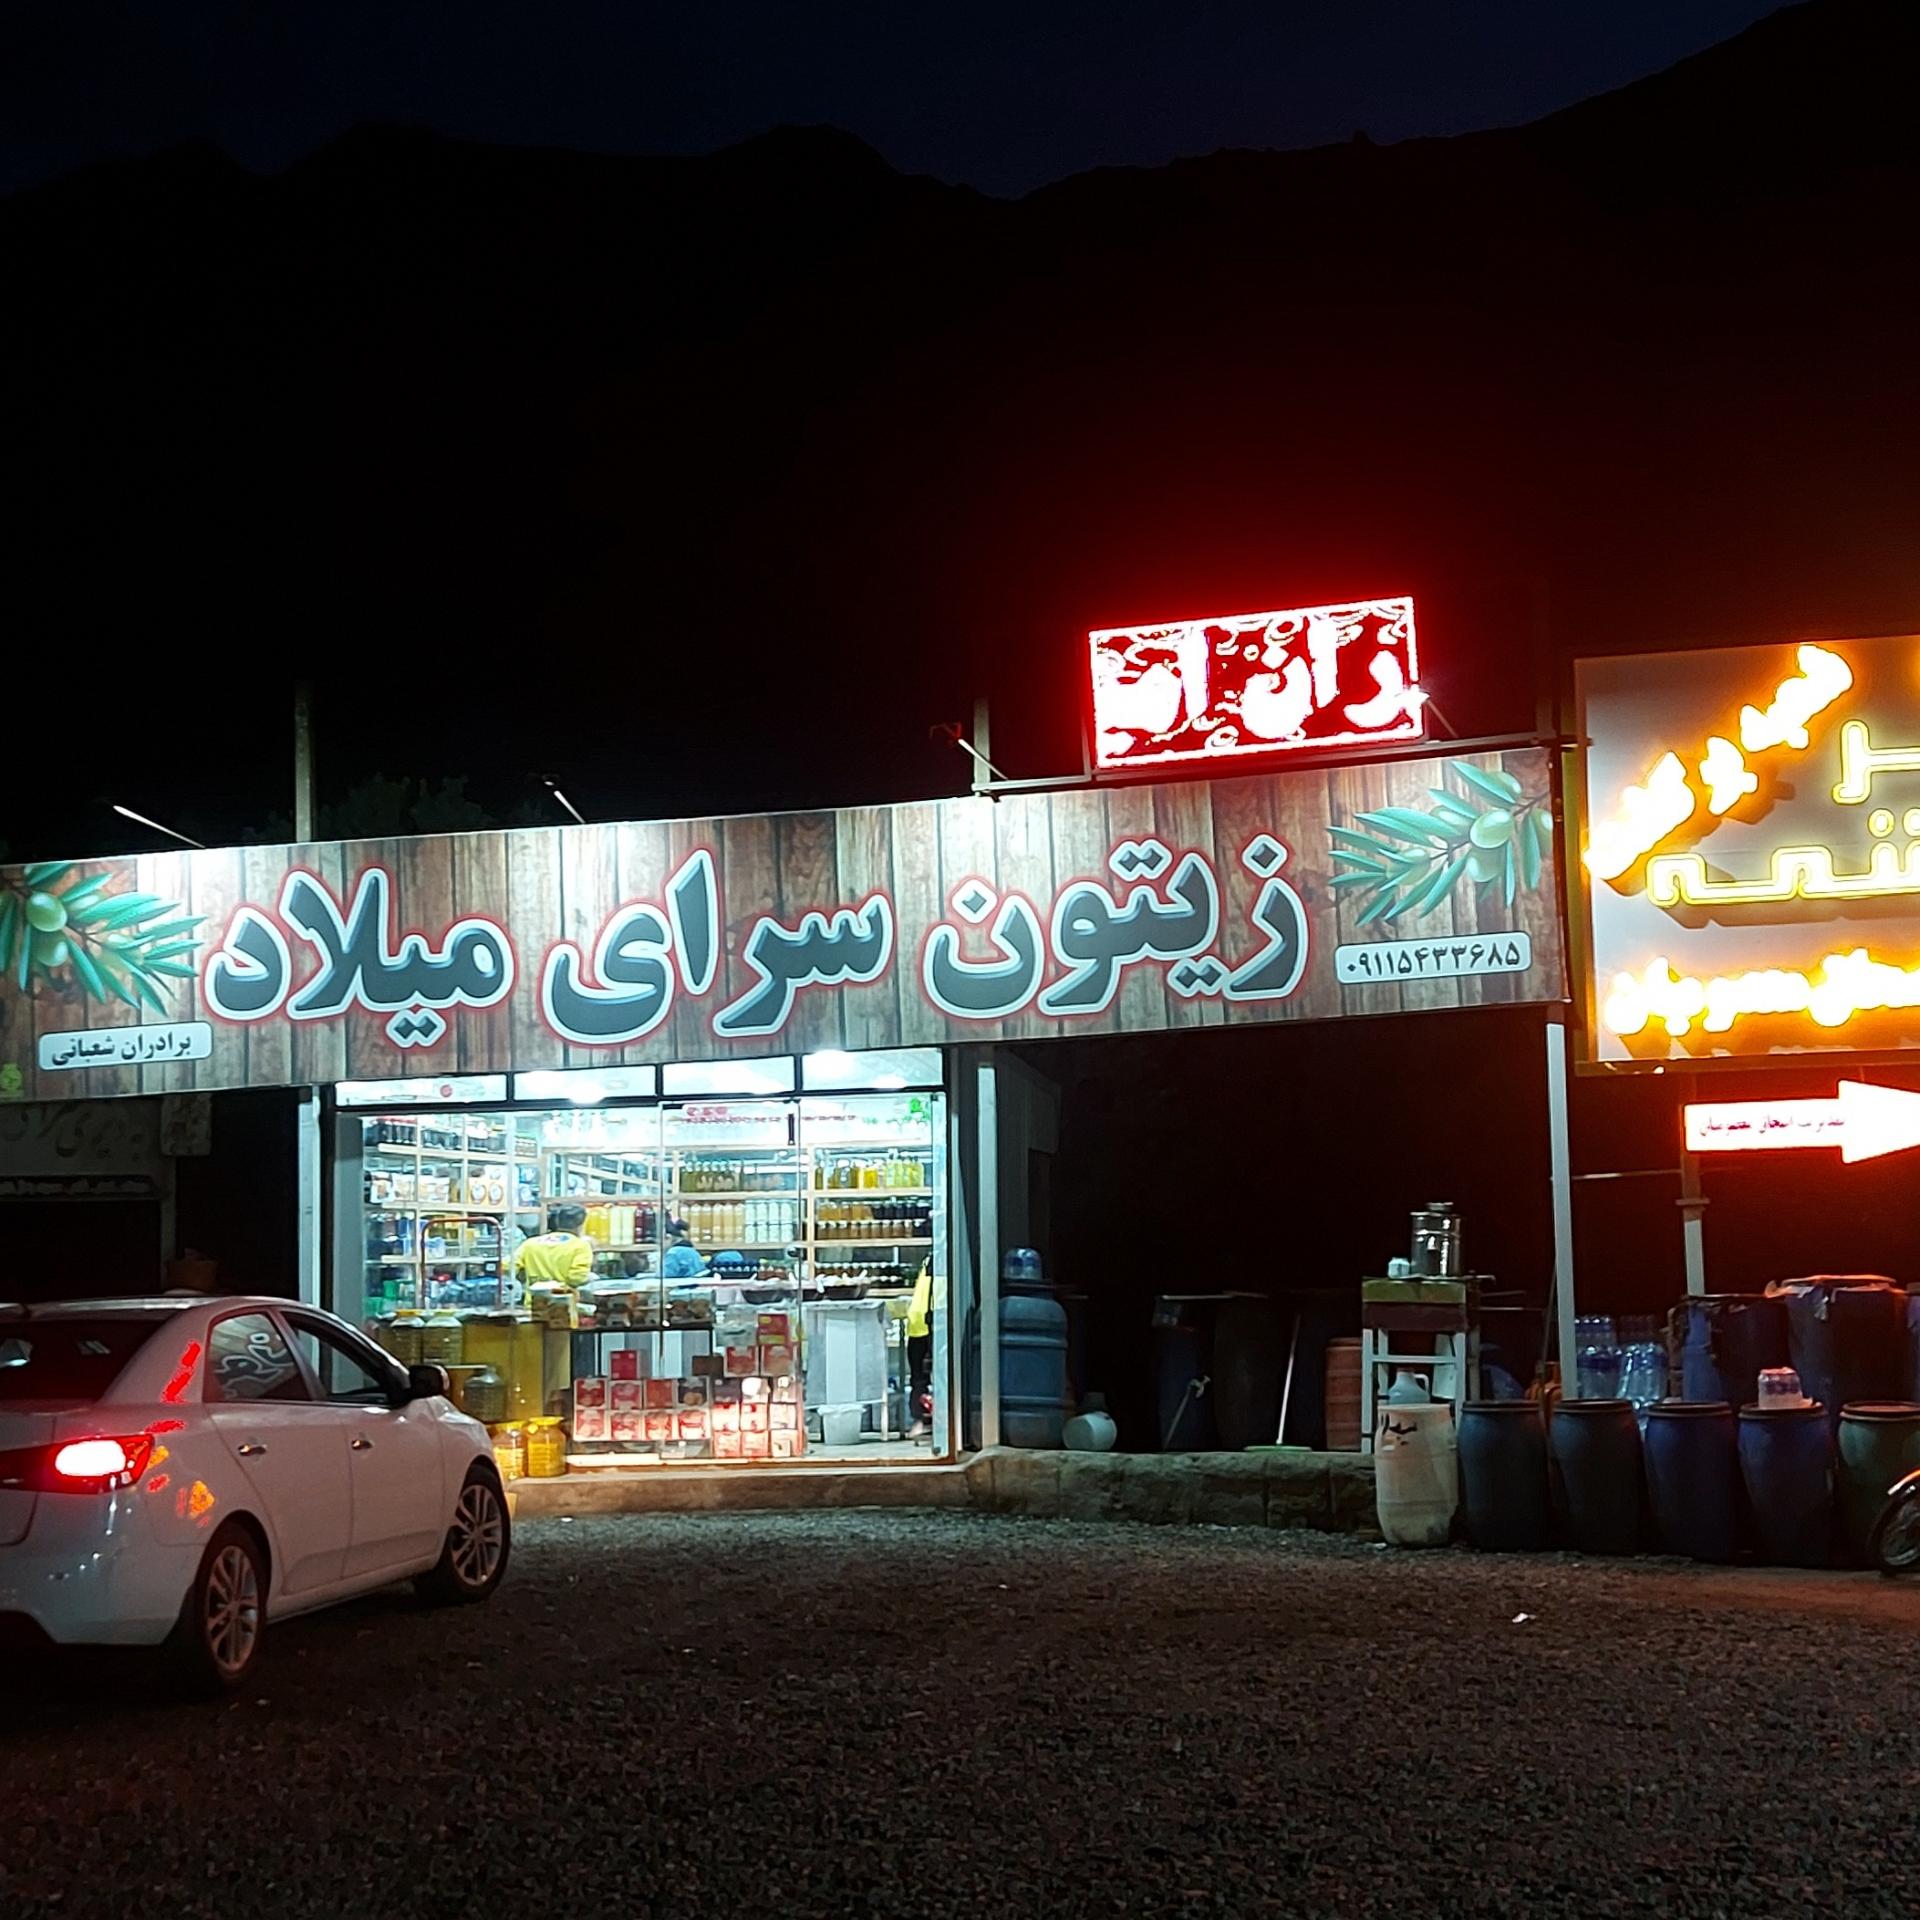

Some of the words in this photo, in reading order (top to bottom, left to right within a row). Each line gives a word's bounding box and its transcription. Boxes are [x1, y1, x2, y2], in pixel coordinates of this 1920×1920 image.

[204, 866, 515, 1048] میلاد
[541, 849, 893, 1043] سرای
[923, 836, 1308, 1017] زیتون
[1347, 941, 1521, 977] ۰۹۱۱۵۴۳۳۶۸۵
[51, 1035, 116, 1066] شعبانی
[120, 1031, 192, 1060] برادران
